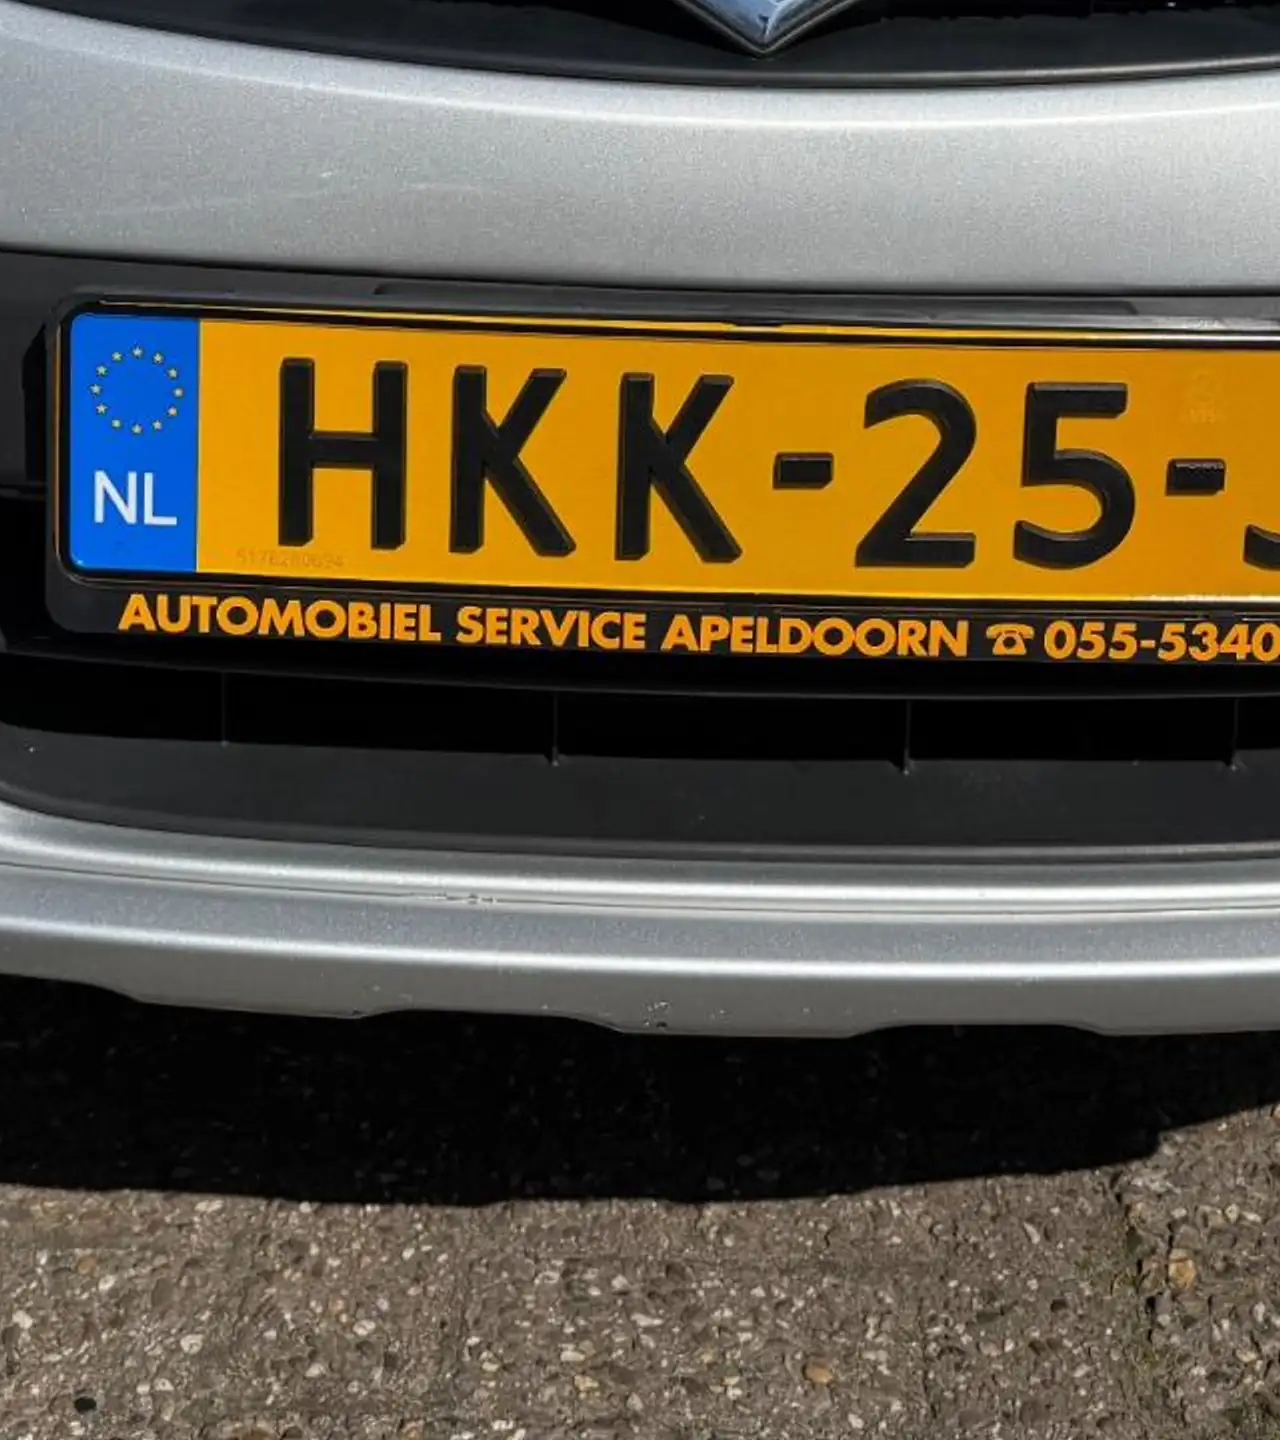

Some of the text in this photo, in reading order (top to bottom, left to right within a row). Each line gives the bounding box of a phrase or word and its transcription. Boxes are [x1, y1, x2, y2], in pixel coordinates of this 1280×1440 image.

[92, 470, 177, 525] NL
[118, 593, 441, 643] AUTOMOBIEL
[456, 605, 646, 651] SERVICE
[662, 613, 968, 658] APELDOORN
